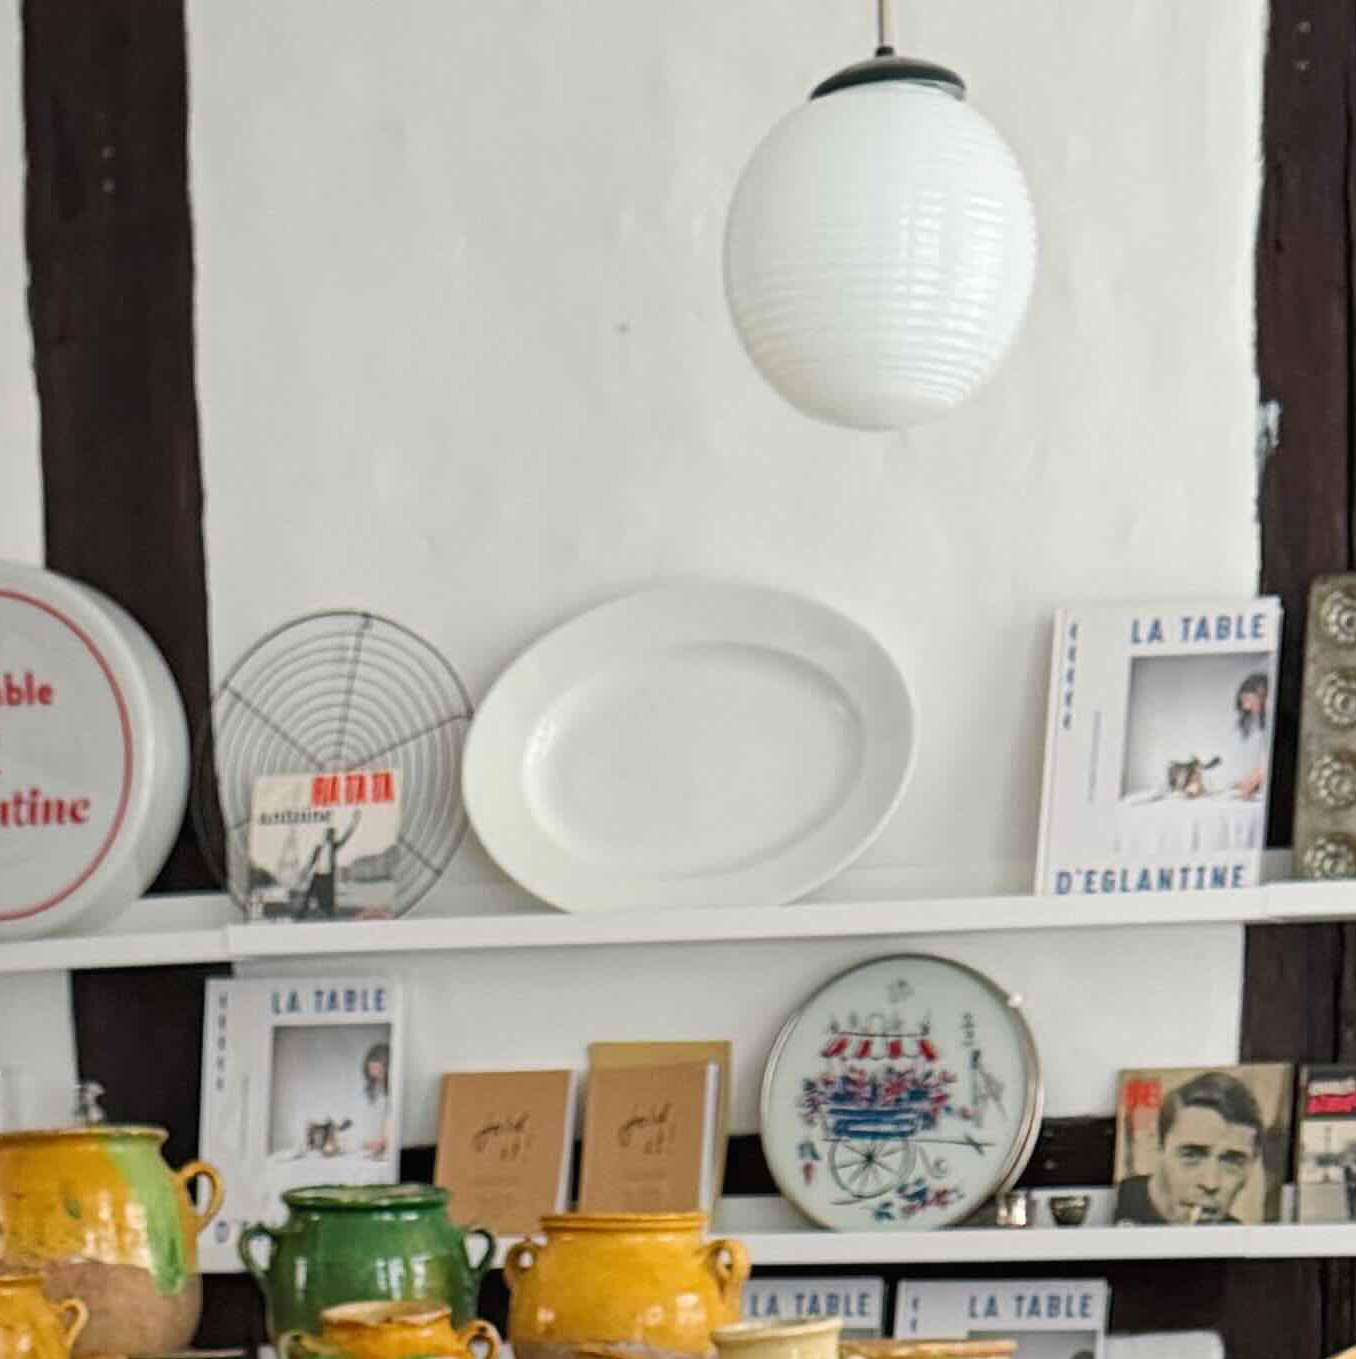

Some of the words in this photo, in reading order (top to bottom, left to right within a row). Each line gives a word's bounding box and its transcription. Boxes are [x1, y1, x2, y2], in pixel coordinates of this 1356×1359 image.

[1130, 617, 1166, 645] LA
[1179, 613, 1267, 642] TABLE
[1055, 864, 1245, 896] D'EGLANTINE
[271, 991, 301, 1015] LA
[313, 988, 386, 1013] TABLE
[749, 1293, 781, 1317] LA
[792, 1292, 872, 1317] TABLE
[969, 1296, 998, 1319] LA
[1009, 1294, 1094, 1319] TABLE
